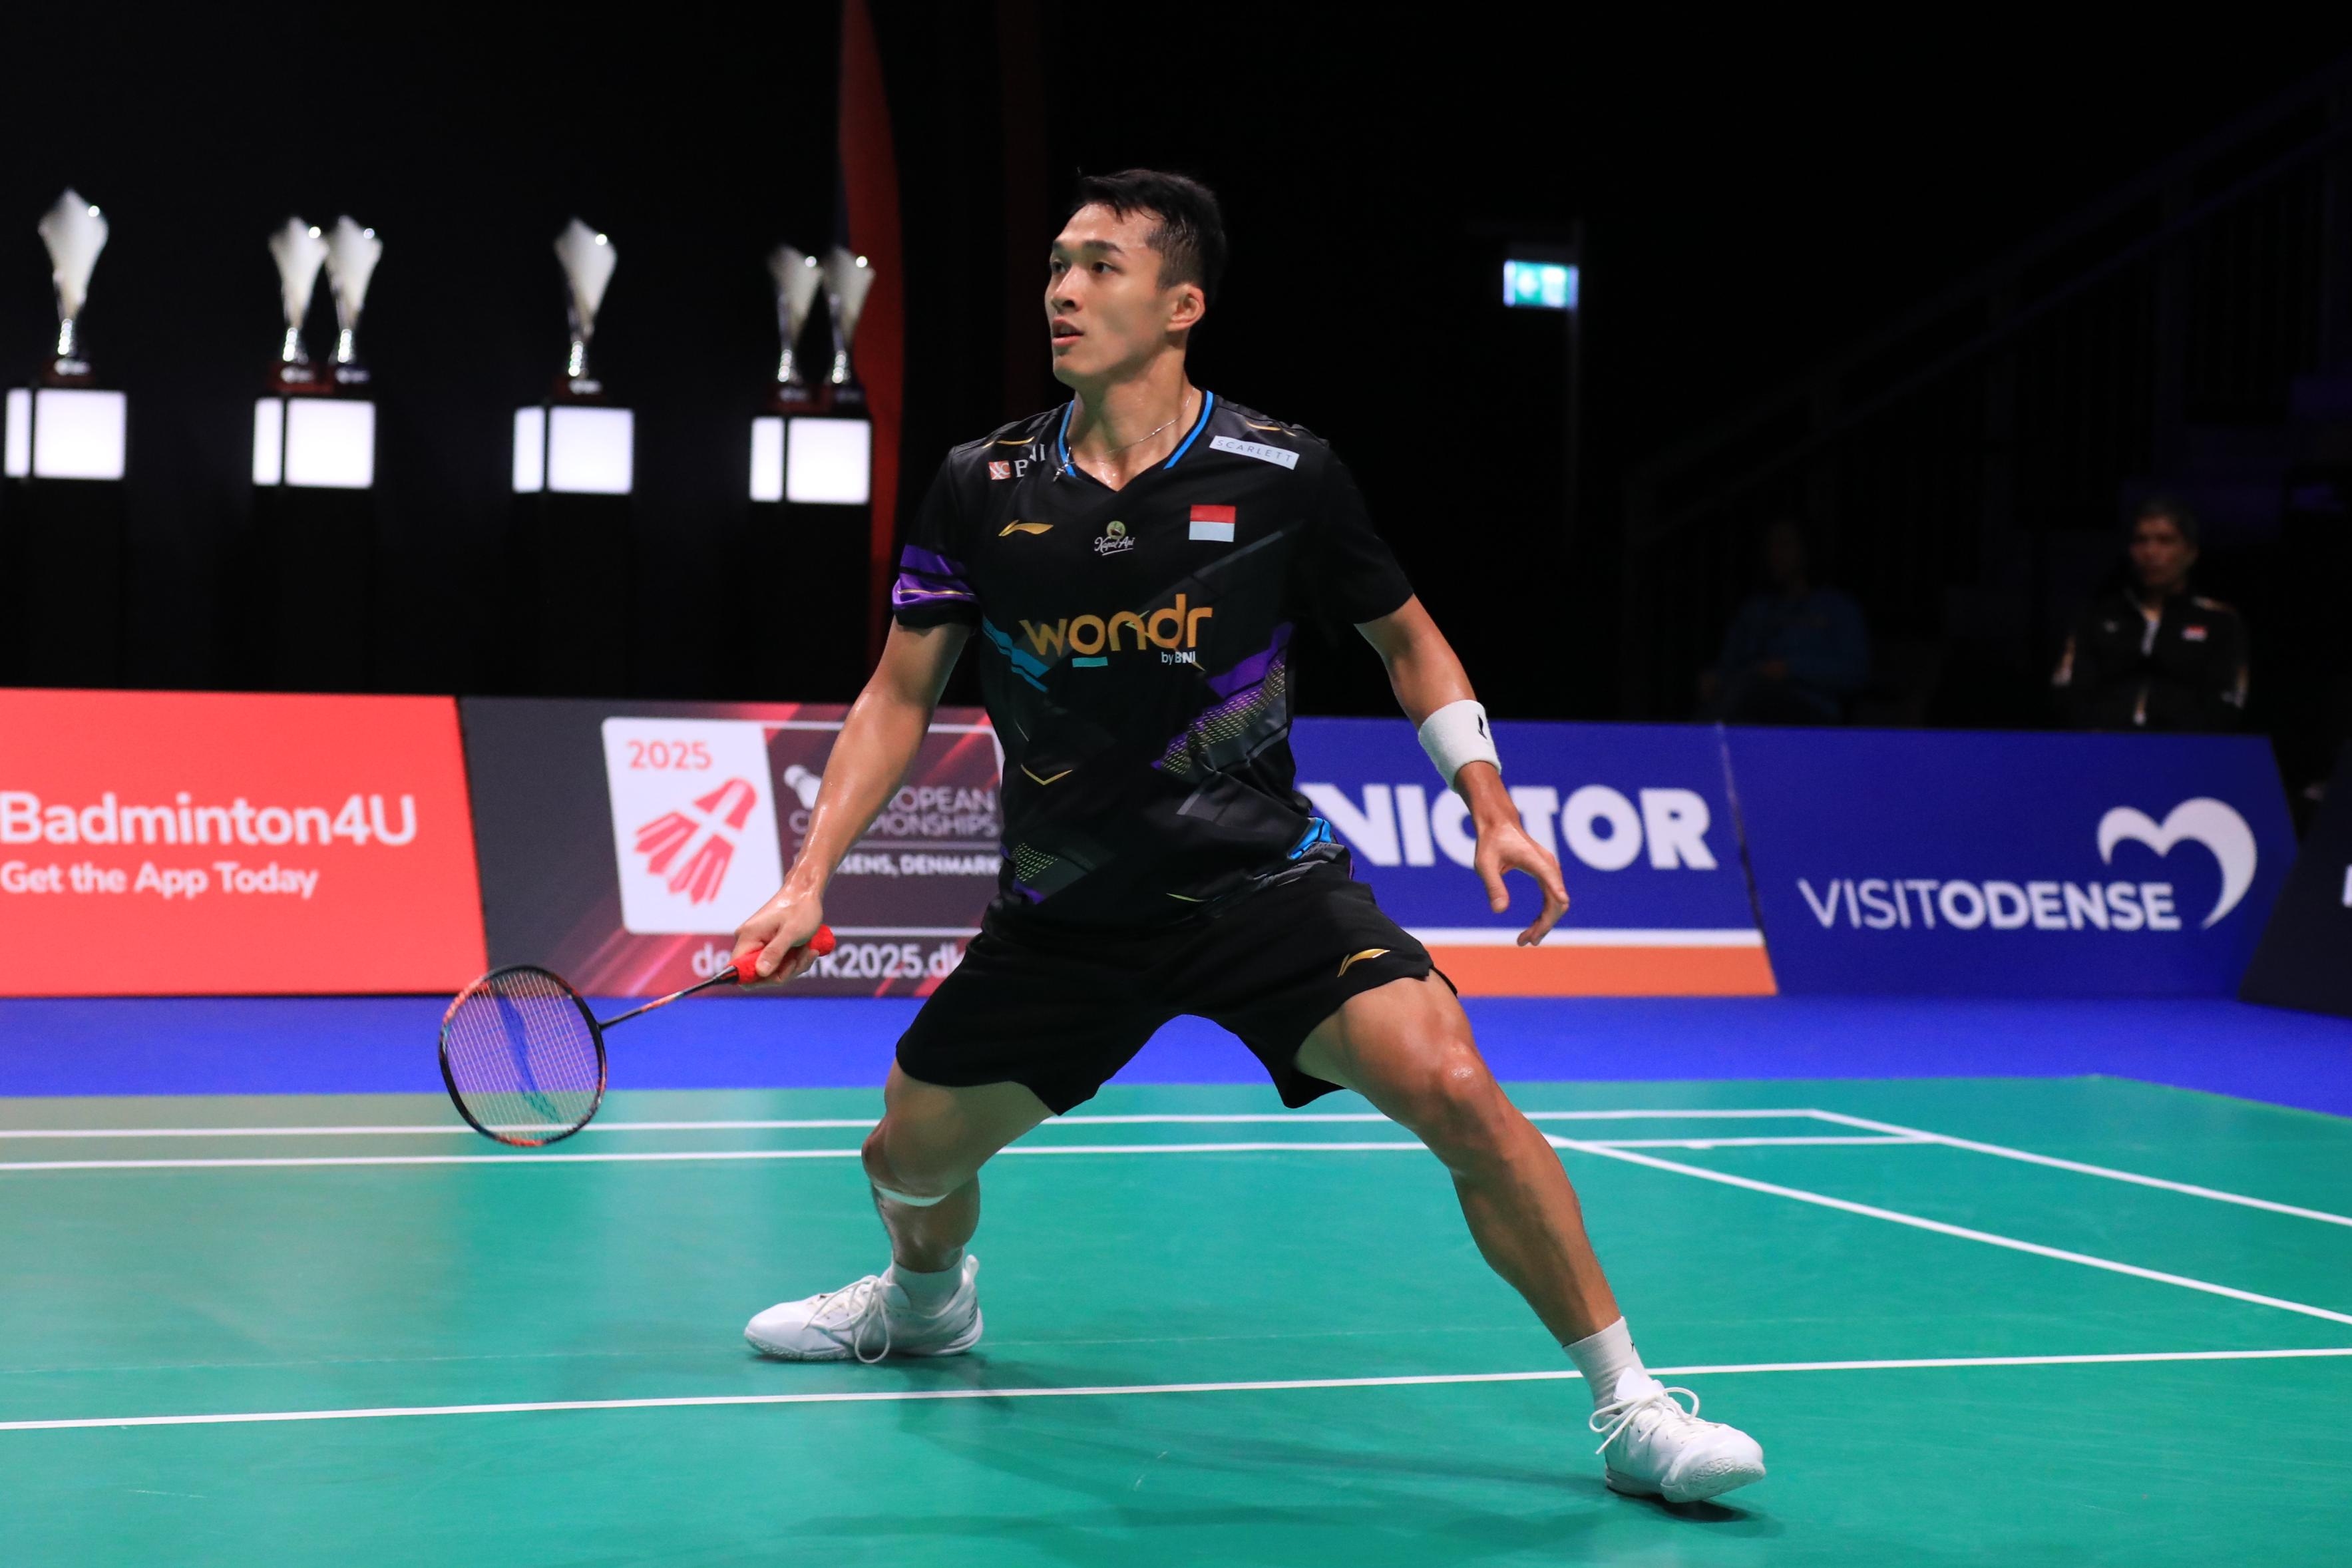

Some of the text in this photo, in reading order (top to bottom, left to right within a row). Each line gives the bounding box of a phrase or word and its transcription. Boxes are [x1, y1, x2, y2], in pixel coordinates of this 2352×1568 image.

[1217, 439, 1292, 462] SCARLETT
[1118, 536, 1135, 549] Api
[1019, 594, 1213, 657] wondr
[1161, 651, 1196, 666] by BNI
[627, 740, 713, 770] 2025
[888, 784, 997, 813] OPEAN
[0, 791, 417, 845] Badminton4U
[789, 809, 1000, 838] CIONSHIPS
[1299, 783, 1718, 871] VICTOR
[793, 853, 1001, 877] SENS, DENMARK
[0, 861, 319, 900] Get the App Today
[1797, 879, 2182, 930] VISITODENSE
[691, 941, 966, 979] dek2025.dk
